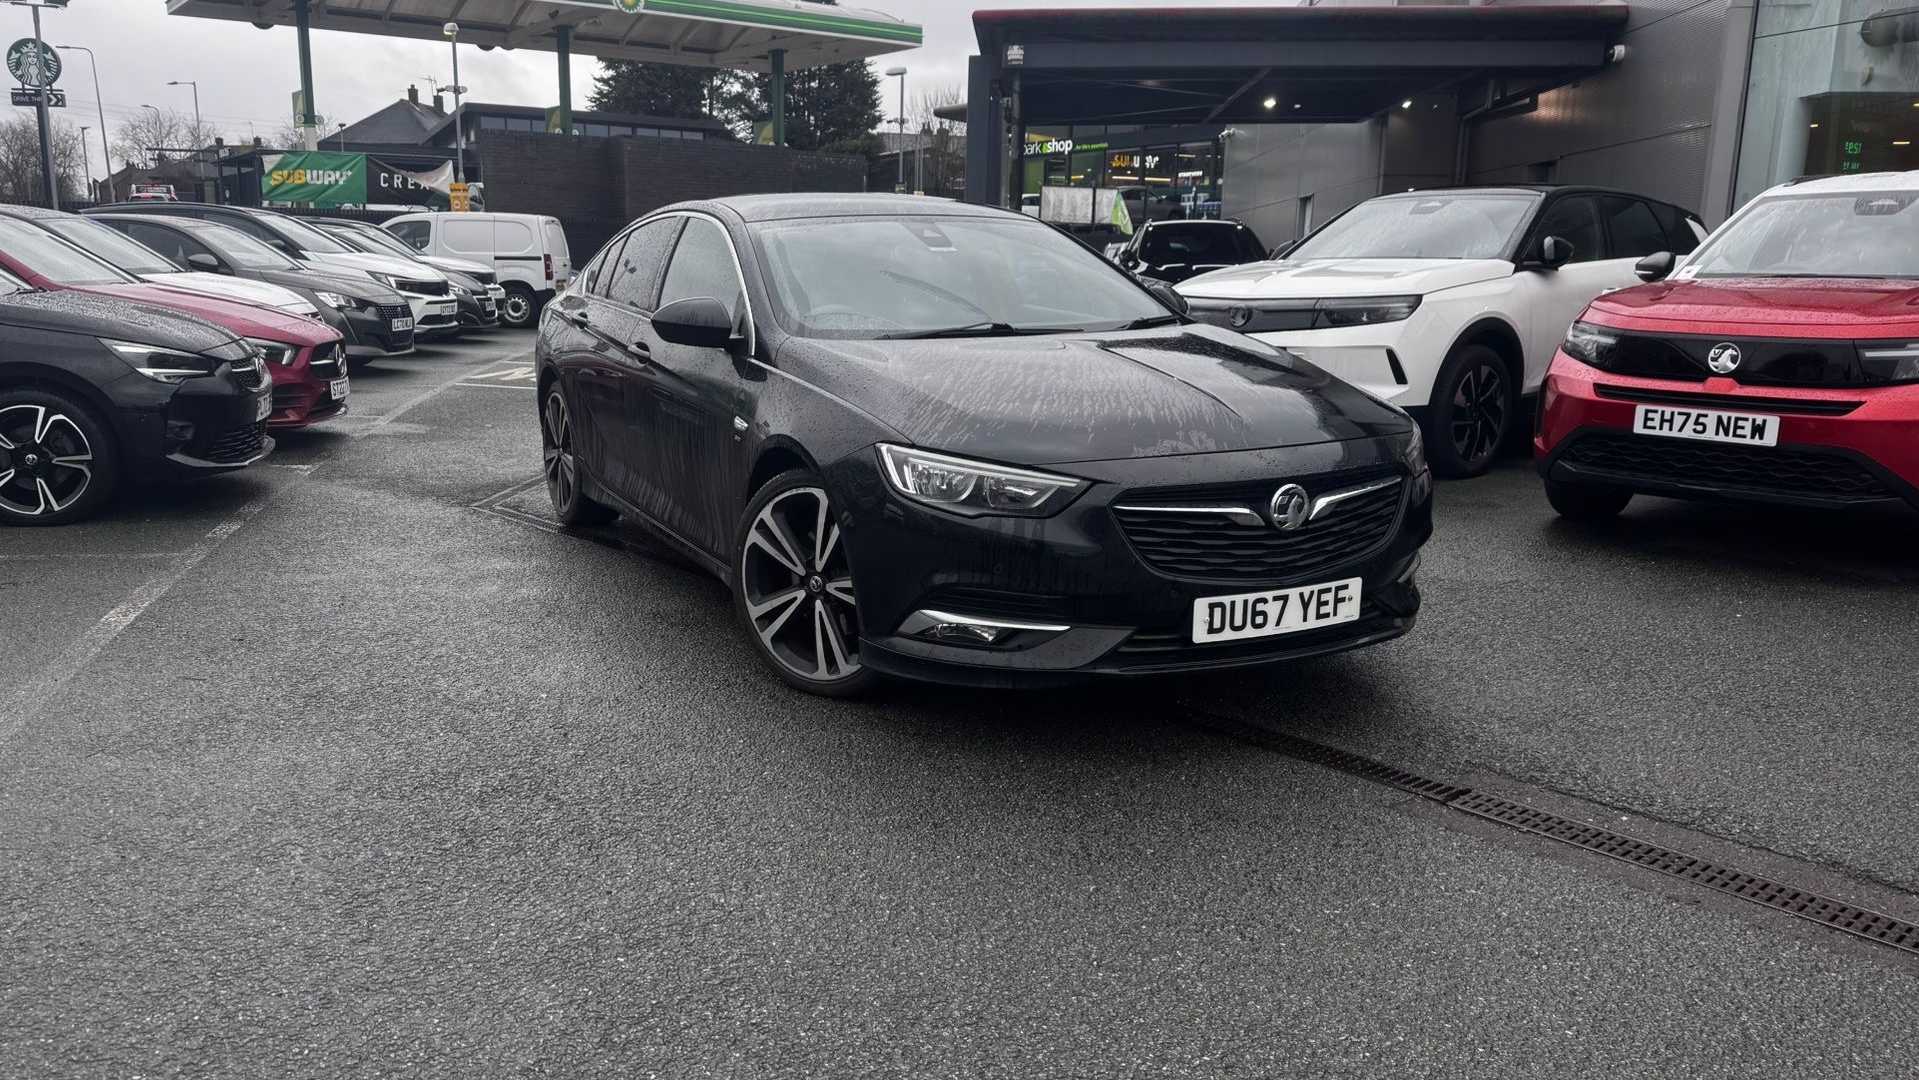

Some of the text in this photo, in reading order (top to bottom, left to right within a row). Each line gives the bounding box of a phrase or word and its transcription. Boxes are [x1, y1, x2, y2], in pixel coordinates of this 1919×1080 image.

[1046, 137, 1073, 155] shop
[271, 169, 348, 186] SUBWAY
[1642, 408, 1767, 441] EH75 NEW
[1207, 584, 1349, 634] DU67 YEF
